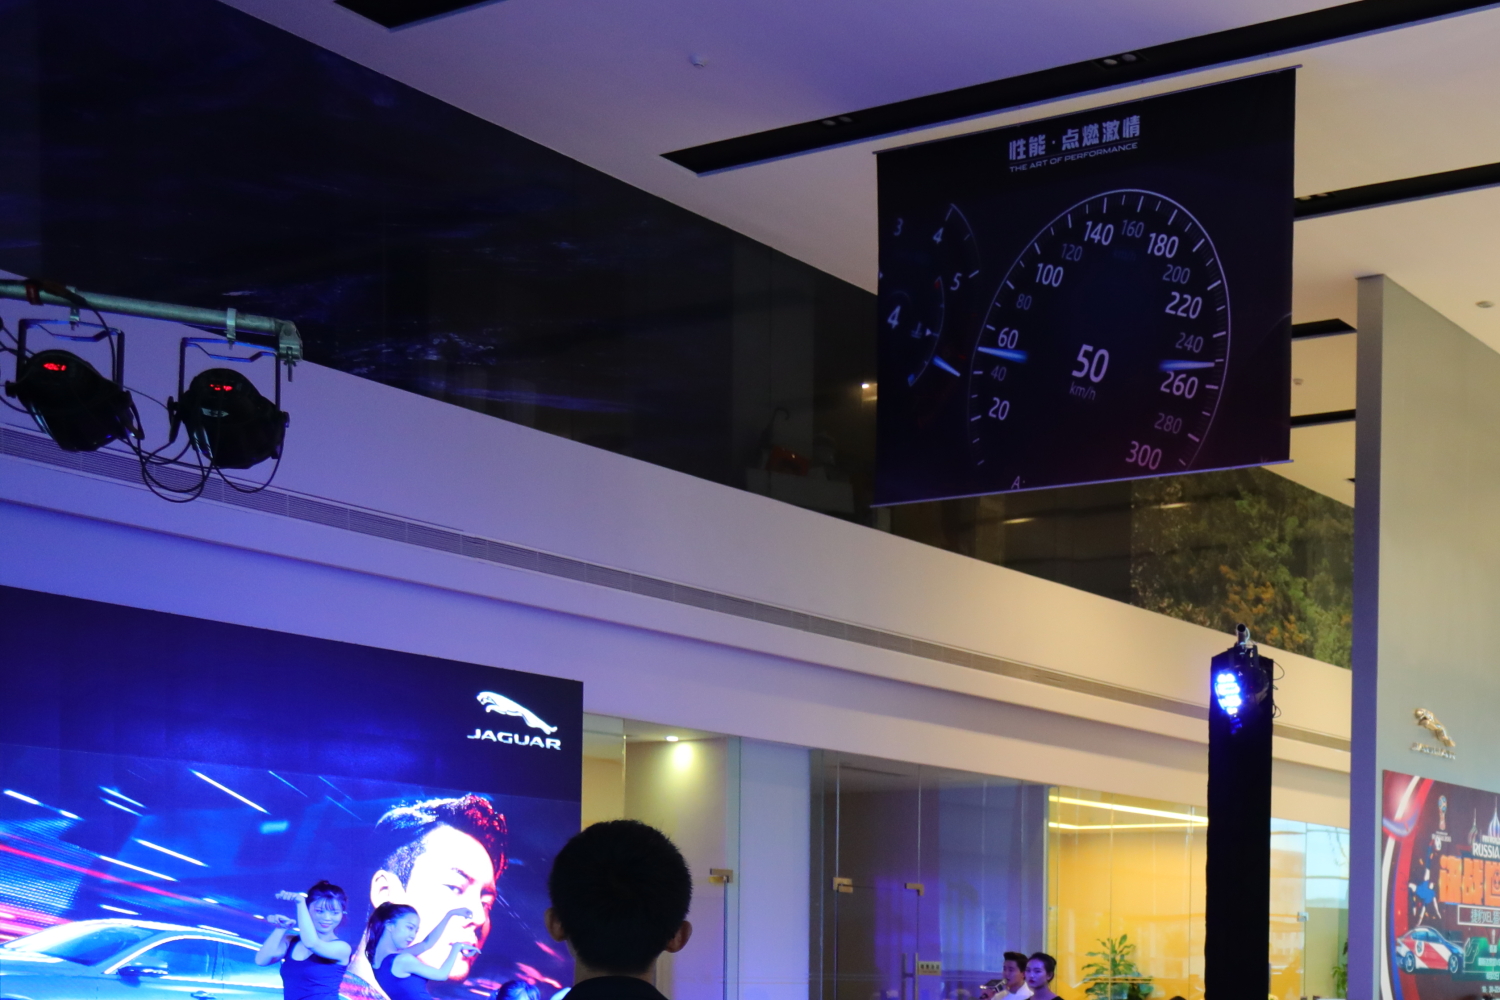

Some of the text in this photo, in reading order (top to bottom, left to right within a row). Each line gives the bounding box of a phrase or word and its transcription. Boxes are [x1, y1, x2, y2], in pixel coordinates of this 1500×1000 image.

[1009, 142, 1139, 173] THE ART OF PERFORMANCE
[932, 227, 945, 245] 4
[1084, 220, 1115, 246] 140
[1121, 219, 1145, 239] 160
[1060, 243, 1083, 262] 120
[1147, 232, 1180, 259] 180
[950, 272, 963, 291] 5
[1035, 262, 1065, 288] 100
[1162, 263, 1191, 285] 200
[1015, 293, 1032, 311] 80
[1164, 291, 1203, 320] 220
[887, 305, 902, 329] 4
[997, 327, 1020, 350] 60
[1174, 332, 1204, 354] 240
[990, 365, 1008, 382] 40
[1071, 343, 1110, 384] 50
[1069, 381, 1097, 400] km/h
[1160, 370, 1200, 400] 260
[988, 396, 1011, 421] 20
[1153, 412, 1183, 434] 280
[1125, 440, 1163, 470] 300
[466, 728, 562, 751] JAGUAR
[1472, 842, 1500, 858] RUSSIA
